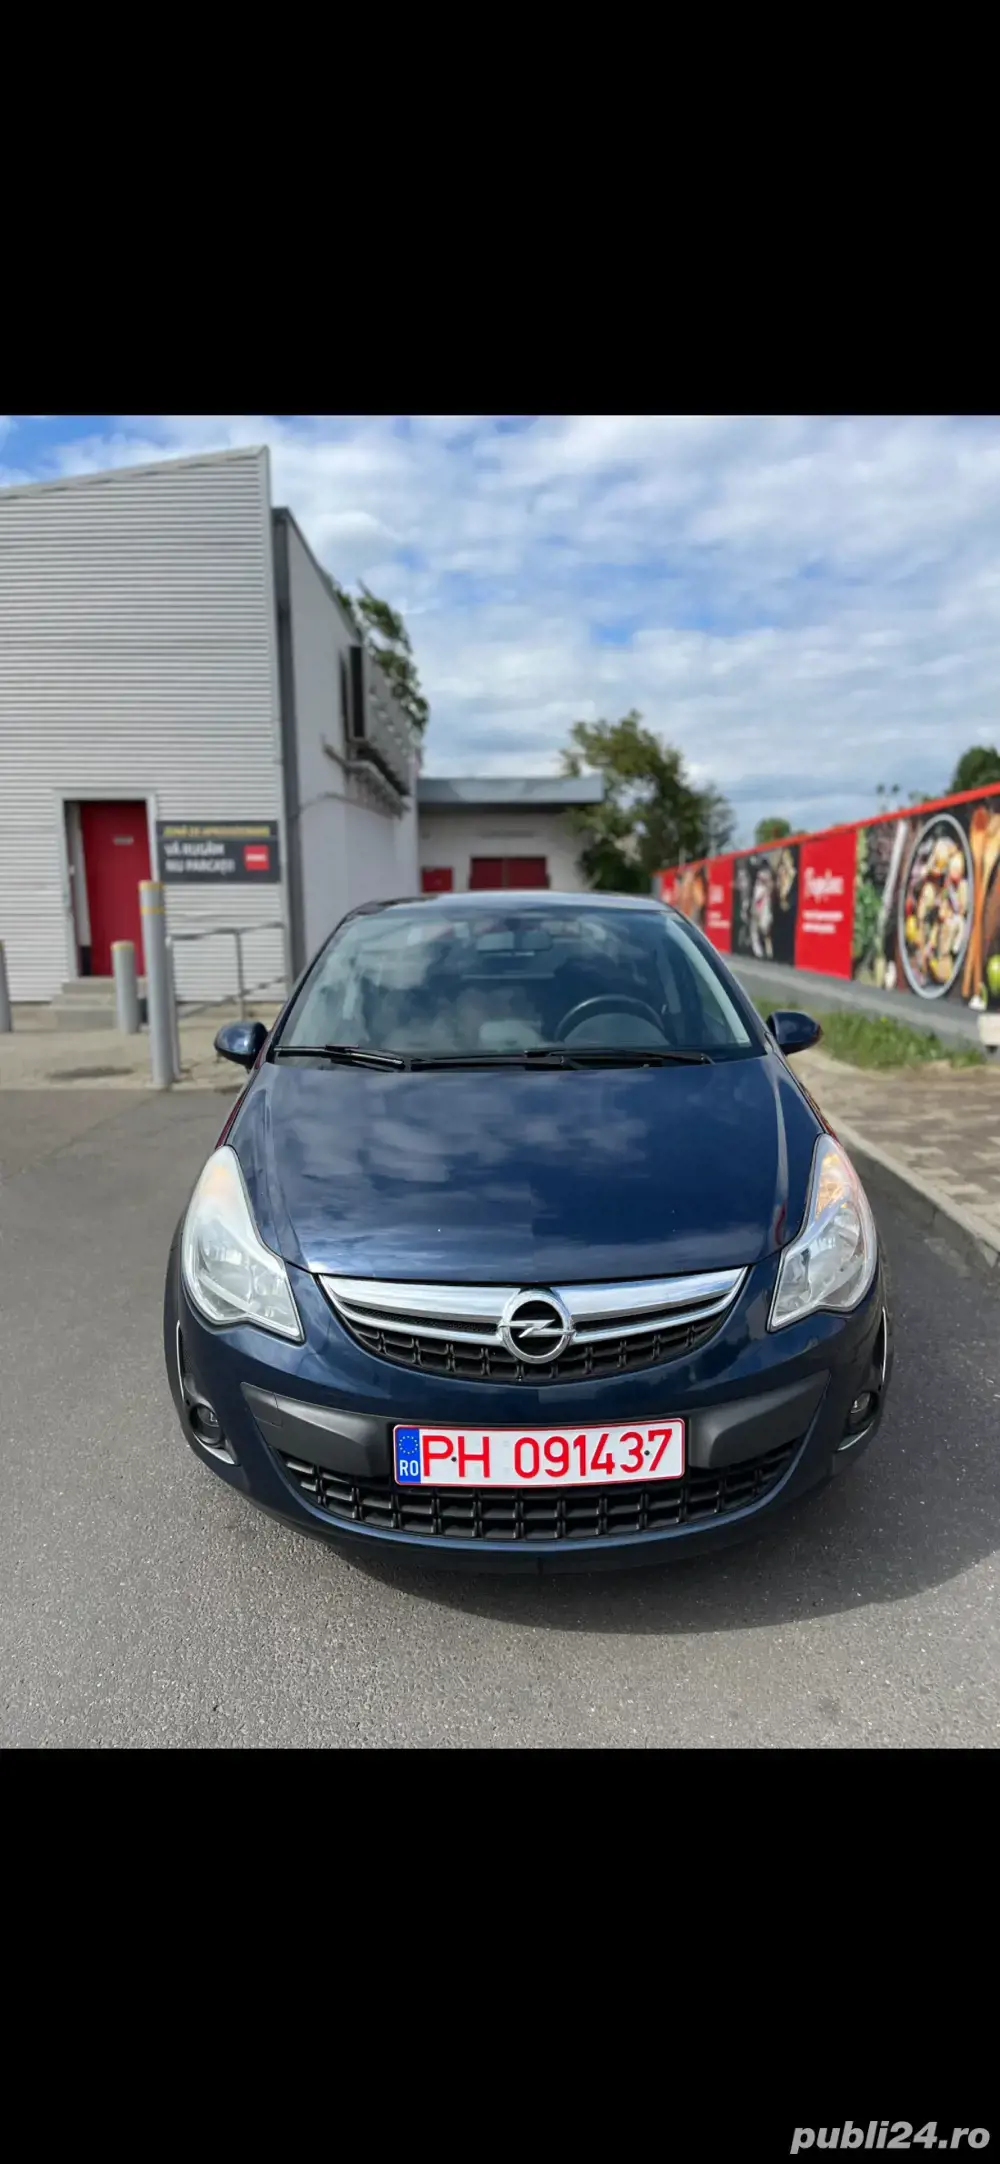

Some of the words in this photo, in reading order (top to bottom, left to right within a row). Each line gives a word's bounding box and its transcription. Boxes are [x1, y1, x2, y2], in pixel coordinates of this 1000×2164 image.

[400, 1459, 419, 1477] RO
[421, 1434, 491, 1478] PH
[514, 1428, 673, 1479] 091437
